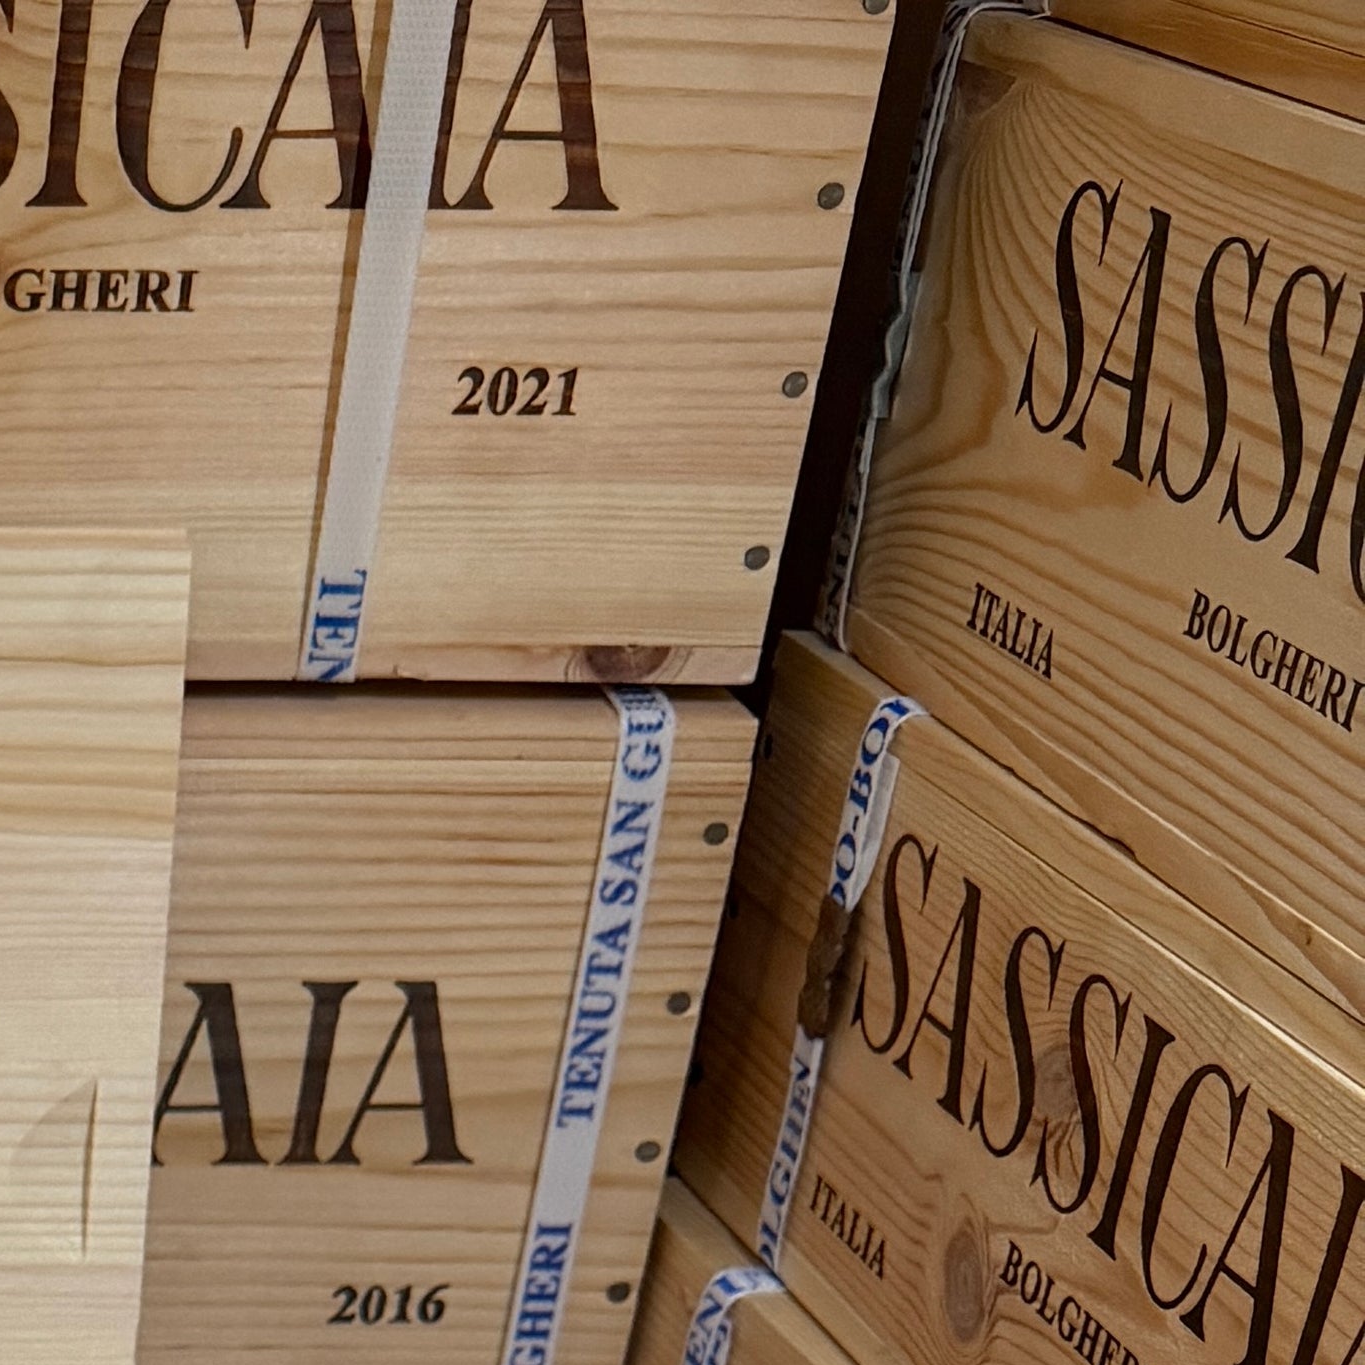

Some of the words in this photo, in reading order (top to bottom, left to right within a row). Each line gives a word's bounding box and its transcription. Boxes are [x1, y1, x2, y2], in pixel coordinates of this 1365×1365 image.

[451, 367, 579, 417] 2021
[966, 582, 1056, 680] ITALIA
[1182, 587, 1365, 733] BOLGHERI
[557, 919, 631, 1128] TENUTA
[600, 799, 655, 909] SAN
[807, 1174, 888, 1280] ITALIA
[327, 1283, 452, 1326] 2016
